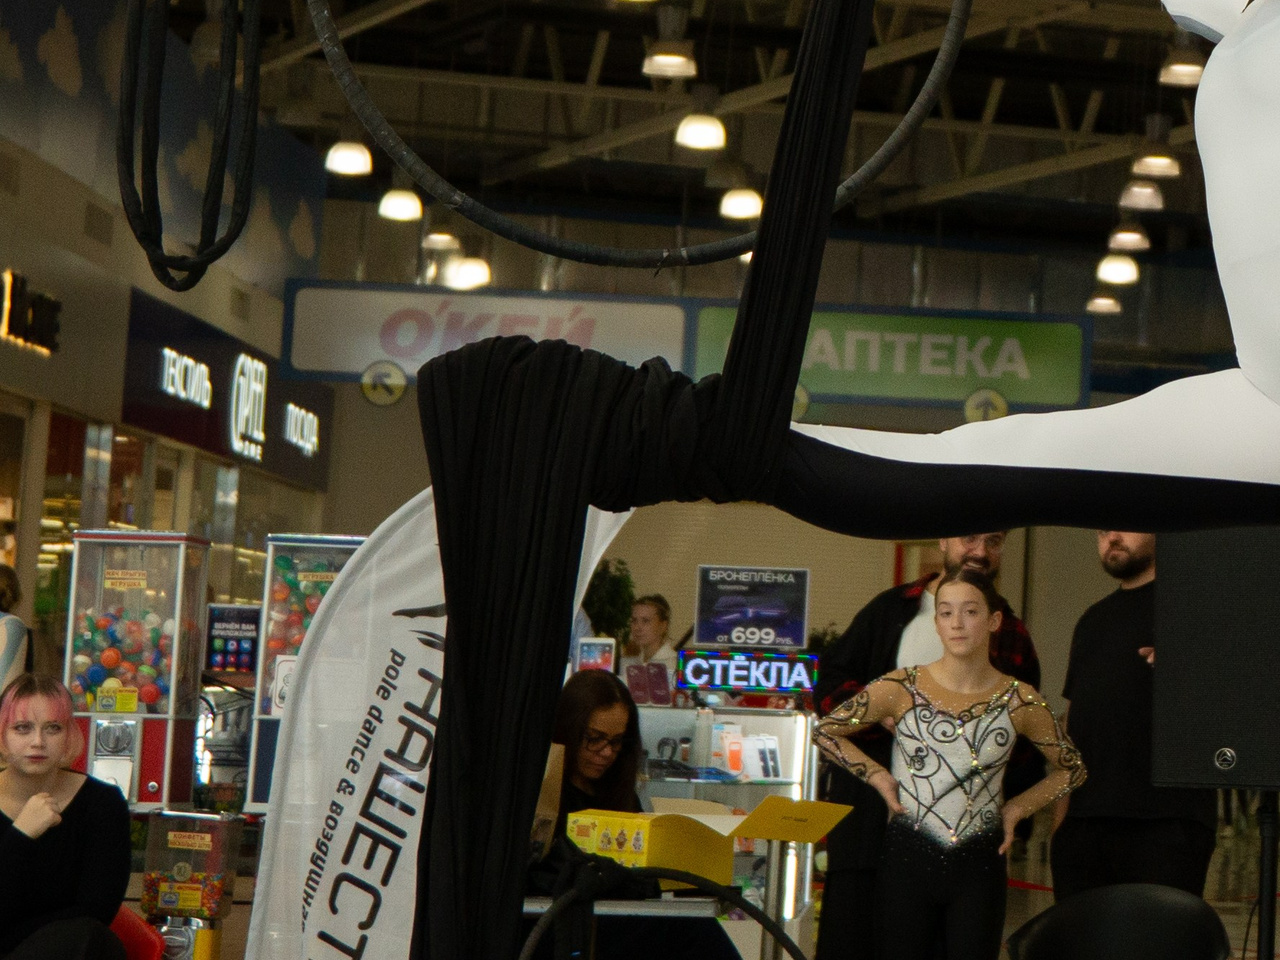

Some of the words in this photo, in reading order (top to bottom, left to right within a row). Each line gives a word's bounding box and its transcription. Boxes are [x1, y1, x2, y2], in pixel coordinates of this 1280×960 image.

[801, 328, 1031, 380] АПТЕКА
[709, 569, 795, 584] БРОНЕПЛЁНКА
[731, 627, 775, 644] 699
[374, 648, 407, 702] pole
[685, 655, 811, 689] СТЁКЛА
[346, 703, 385, 775] dance
[336, 777, 357, 796] &
